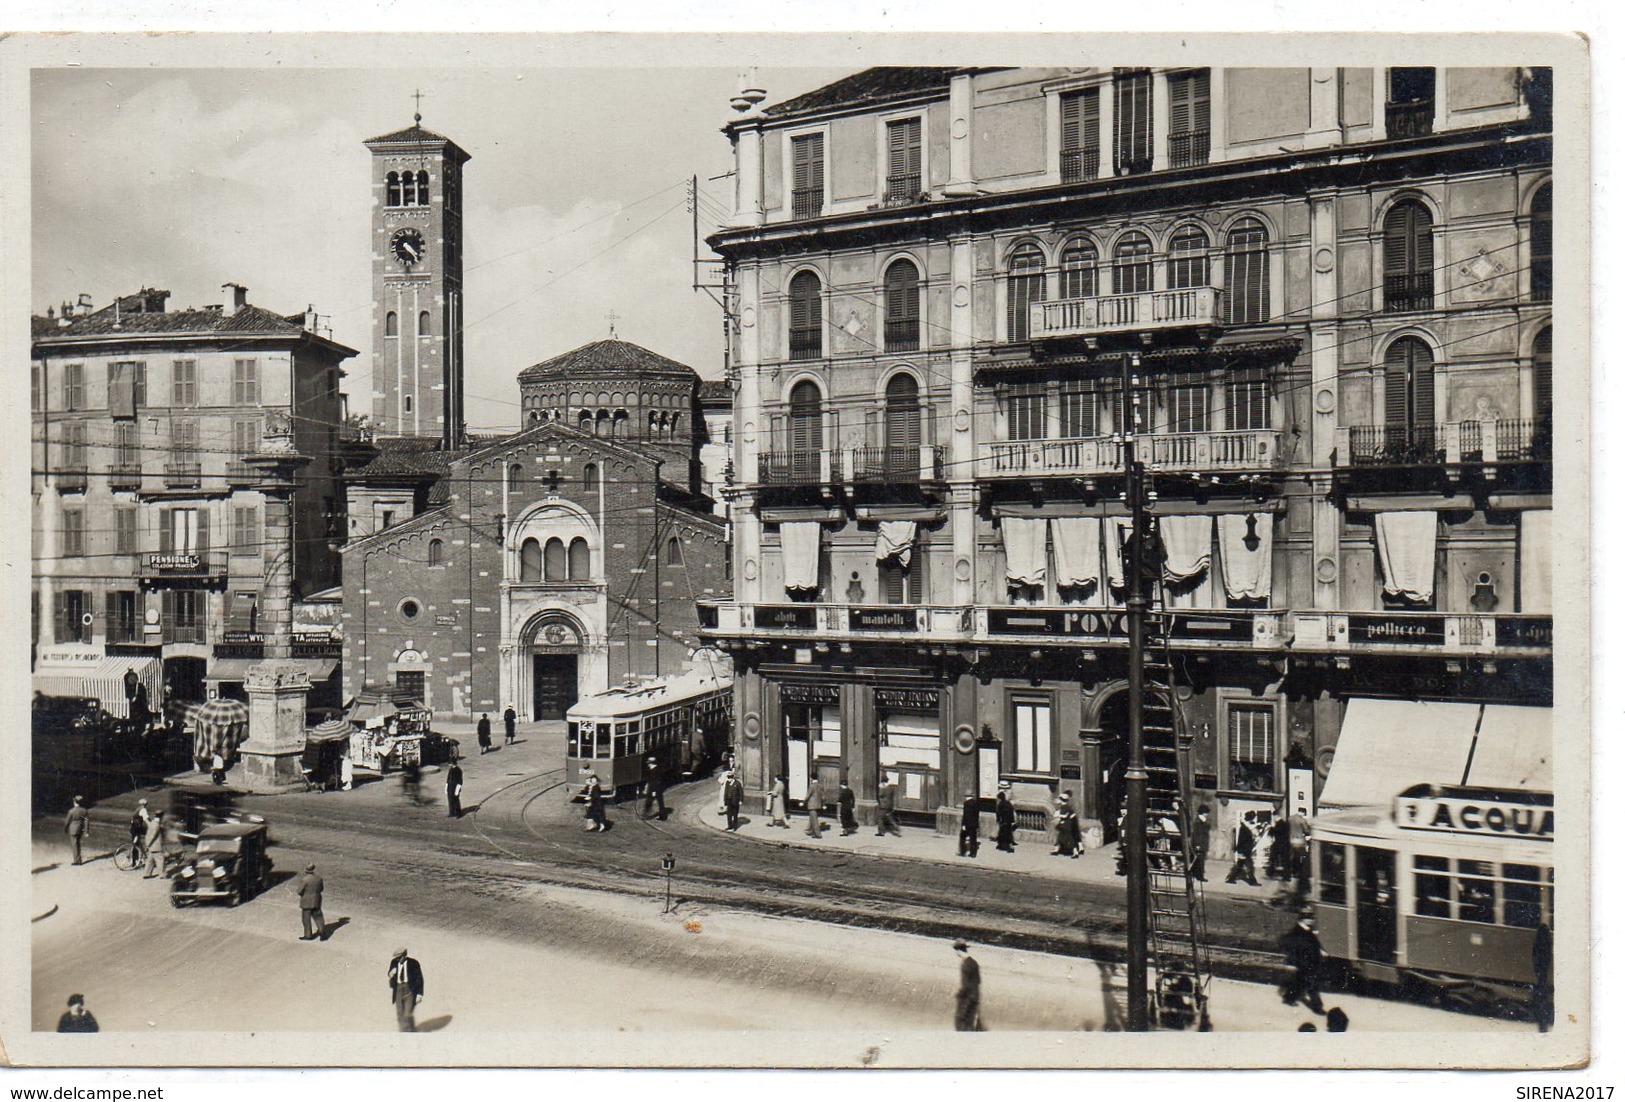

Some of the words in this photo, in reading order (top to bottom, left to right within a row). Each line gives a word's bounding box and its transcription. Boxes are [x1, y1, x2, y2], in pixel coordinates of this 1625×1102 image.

[151, 555, 190, 564] PENSIONE
[862, 613, 904, 625] mantelli
[811, 687, 840, 697] ITALIANO
[877, 690, 906, 701] CREDITO
[908, 691, 938, 702] ITALIANO
